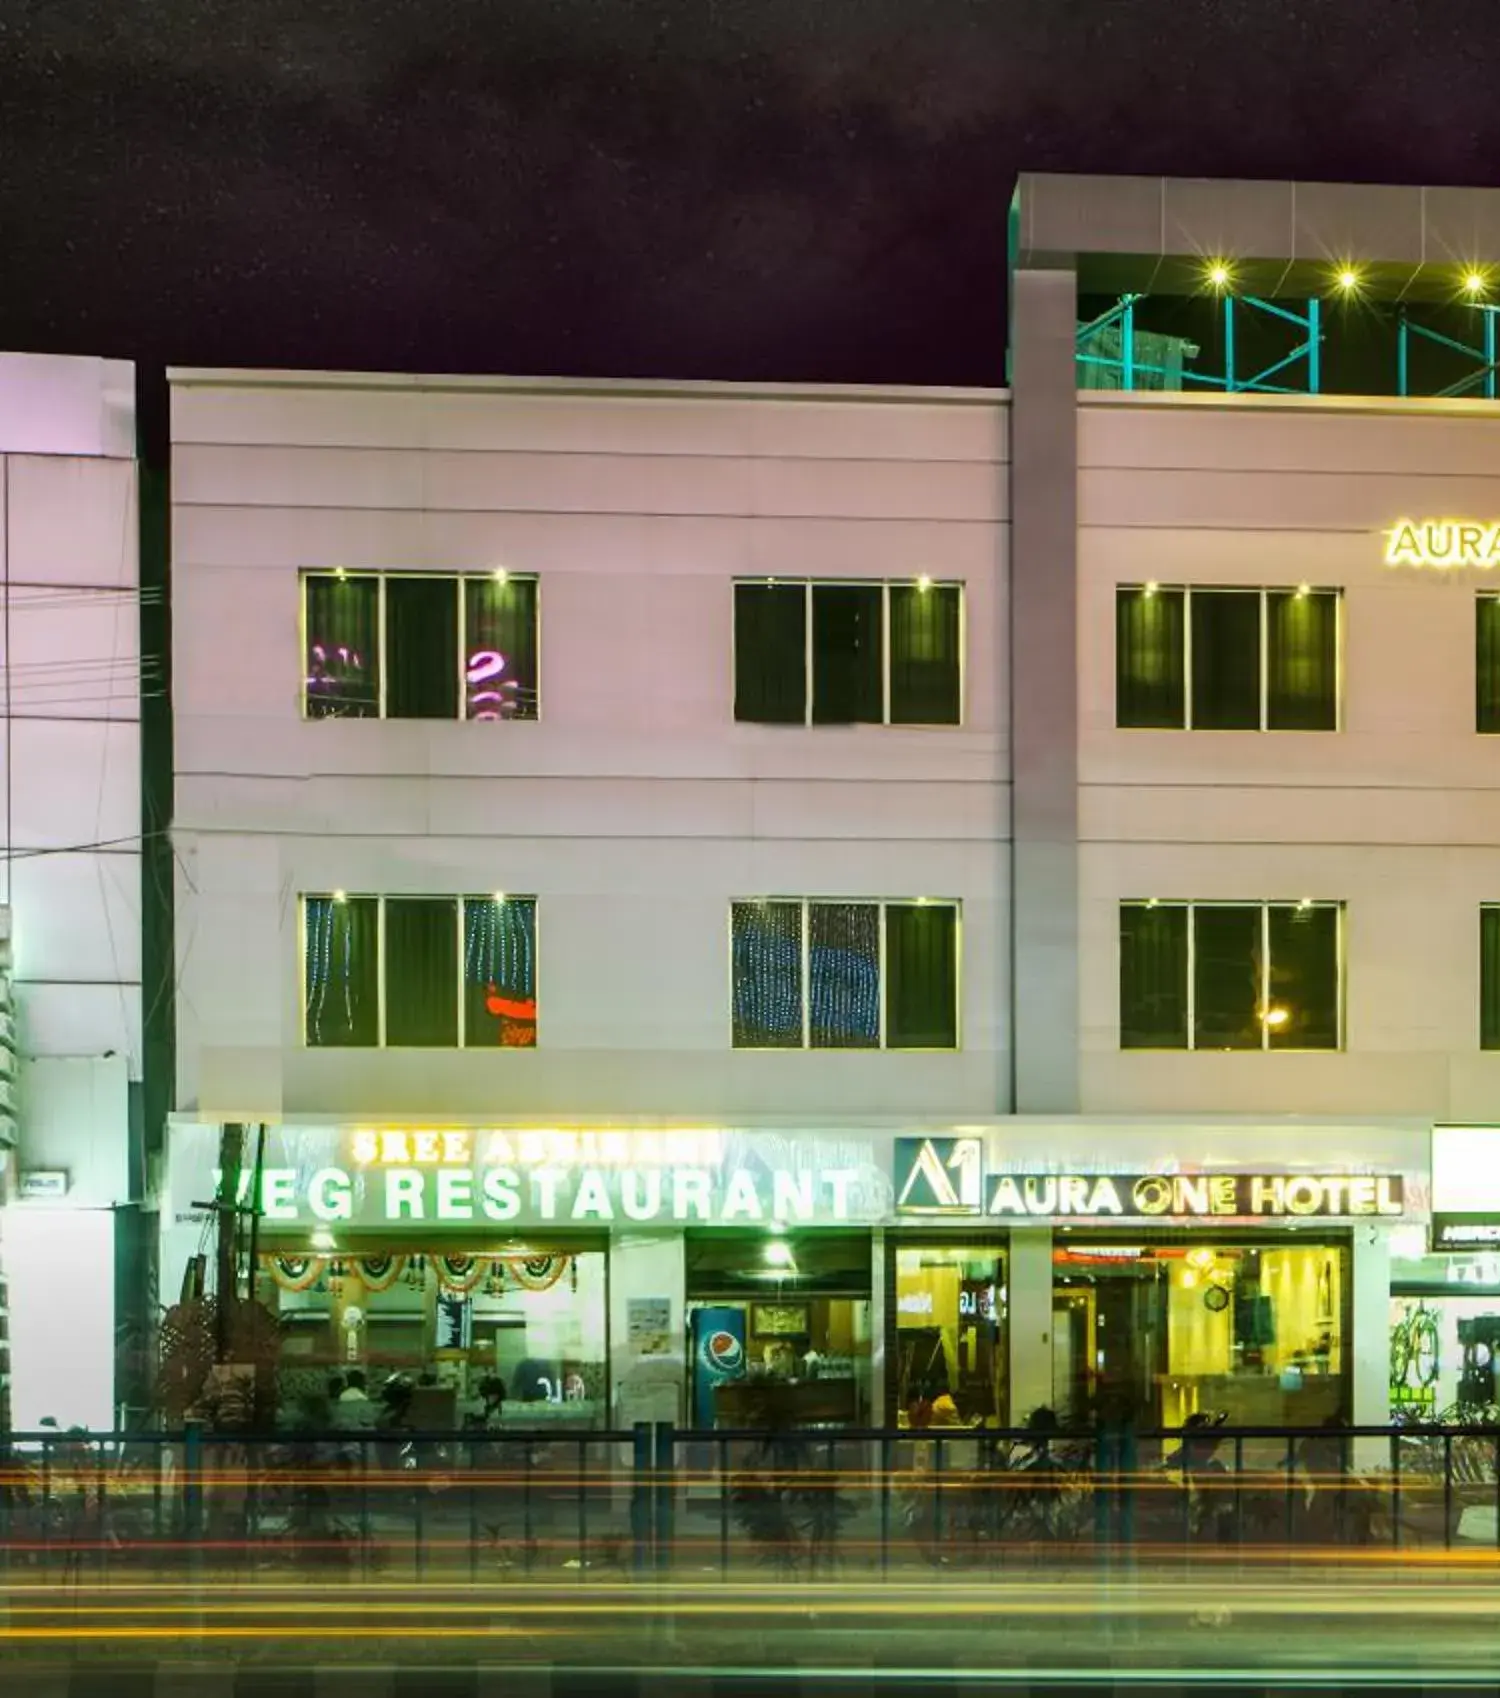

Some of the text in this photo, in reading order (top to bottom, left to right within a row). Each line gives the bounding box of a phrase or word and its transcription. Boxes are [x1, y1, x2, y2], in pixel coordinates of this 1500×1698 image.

[385, 1167, 856, 1220] RESTAURANT
[990, 1176, 1403, 1215] AURA ONE HOTEL
